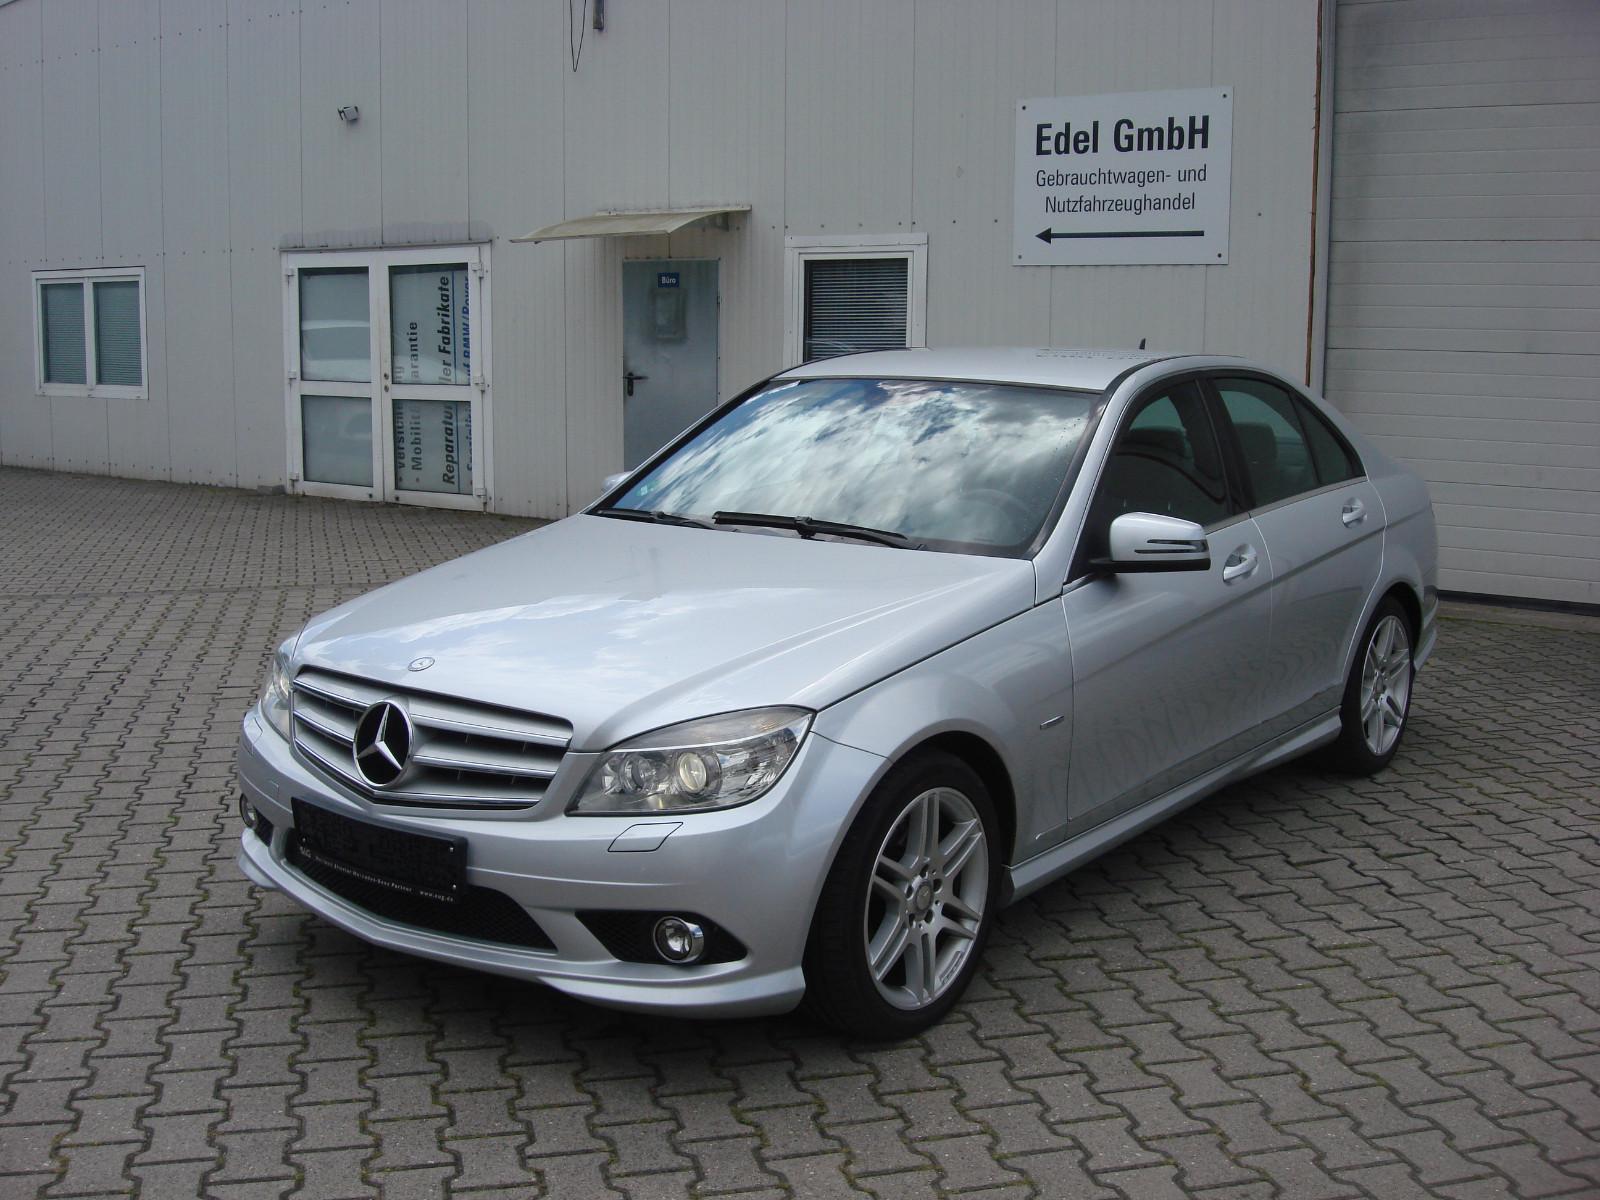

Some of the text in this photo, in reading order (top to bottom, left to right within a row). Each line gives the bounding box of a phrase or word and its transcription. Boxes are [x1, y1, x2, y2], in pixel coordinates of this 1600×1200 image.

[1036, 115, 1209, 155] Edel GmbH
[1036, 164, 1207, 187] Gebrauchtwagen- und
[1045, 192, 1195, 215] Nutzfahrzeughandel
[661, 276, 677, 284] Büro
[436, 276, 451, 354] Fabrikate
